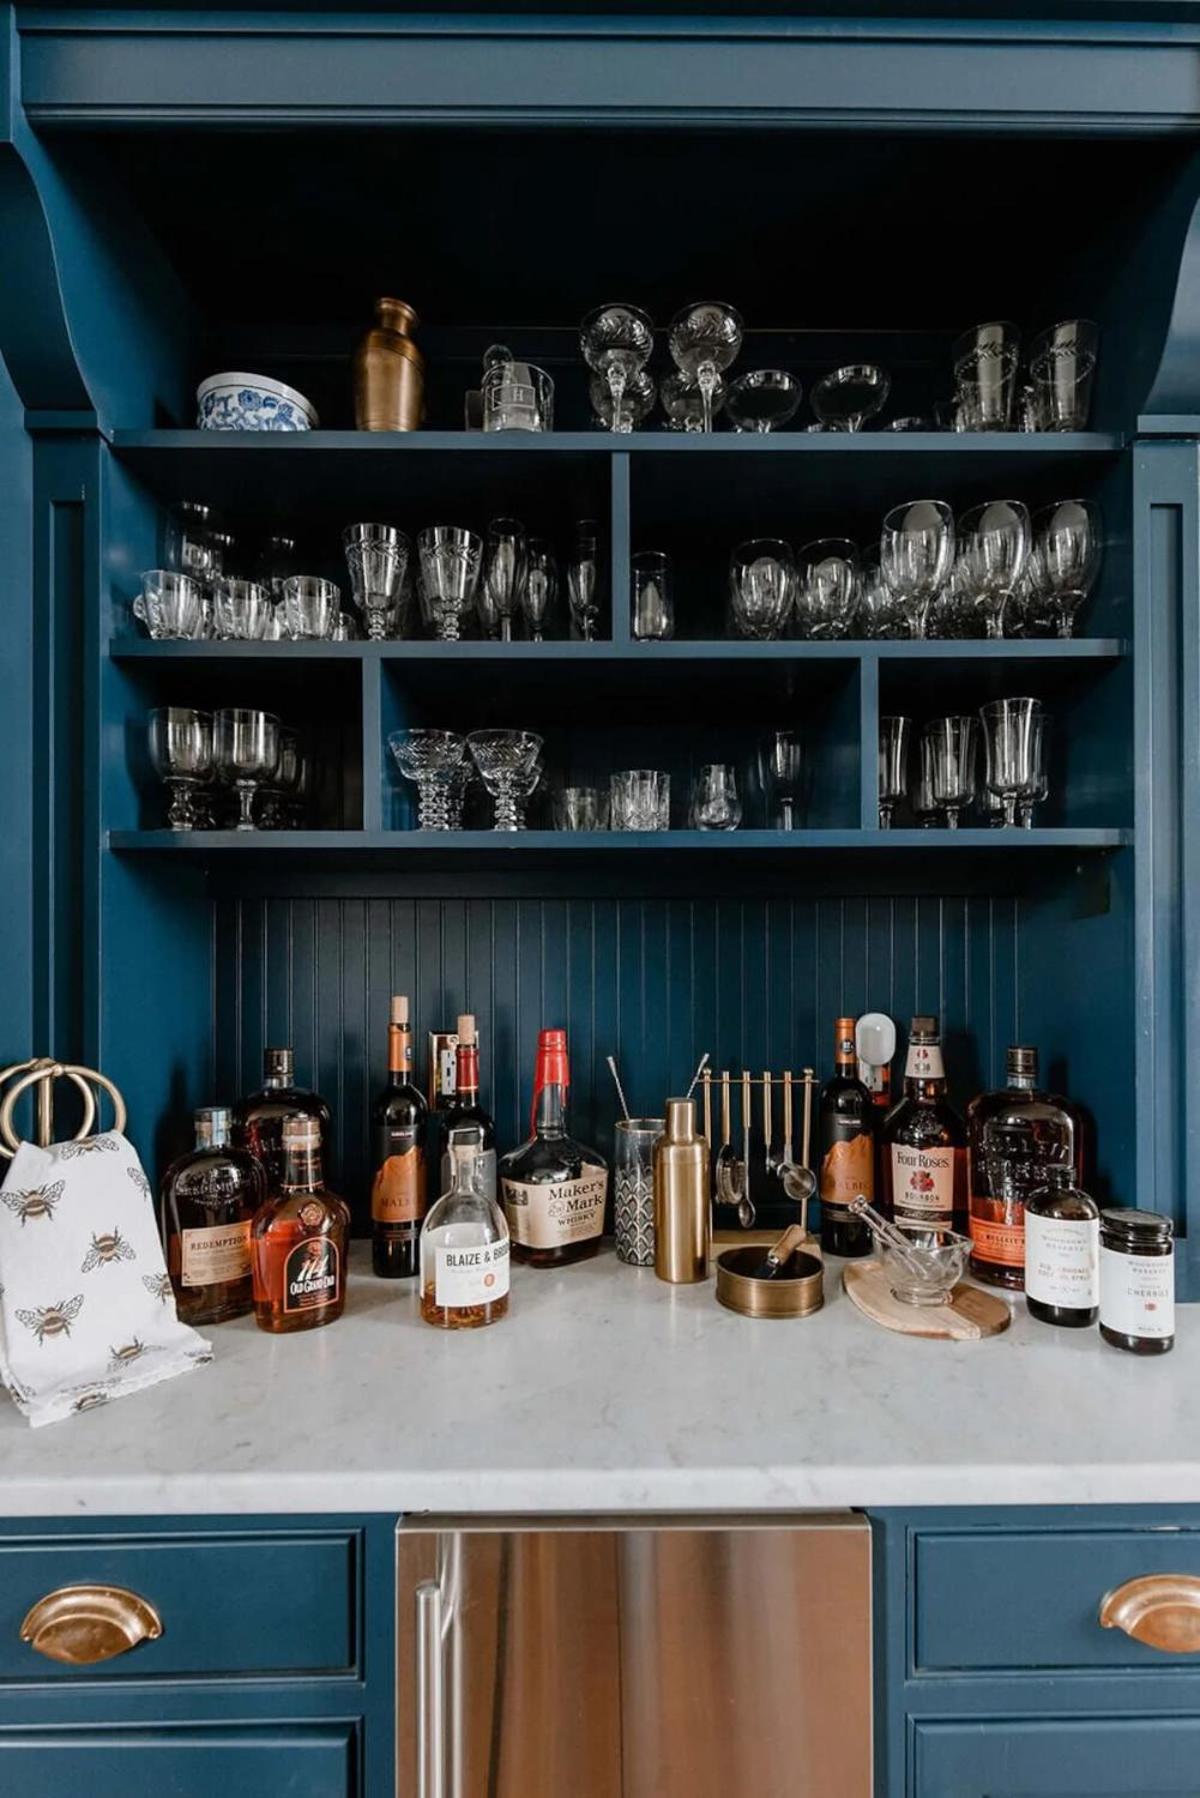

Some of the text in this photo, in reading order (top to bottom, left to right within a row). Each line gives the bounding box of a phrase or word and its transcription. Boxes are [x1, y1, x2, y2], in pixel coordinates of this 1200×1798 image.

[548, 1180, 604, 1201] Maker's
[566, 1194, 603, 1213] Mark
[446, 1252, 482, 1267] BLAIZE
[483, 1250, 491, 1264] &
